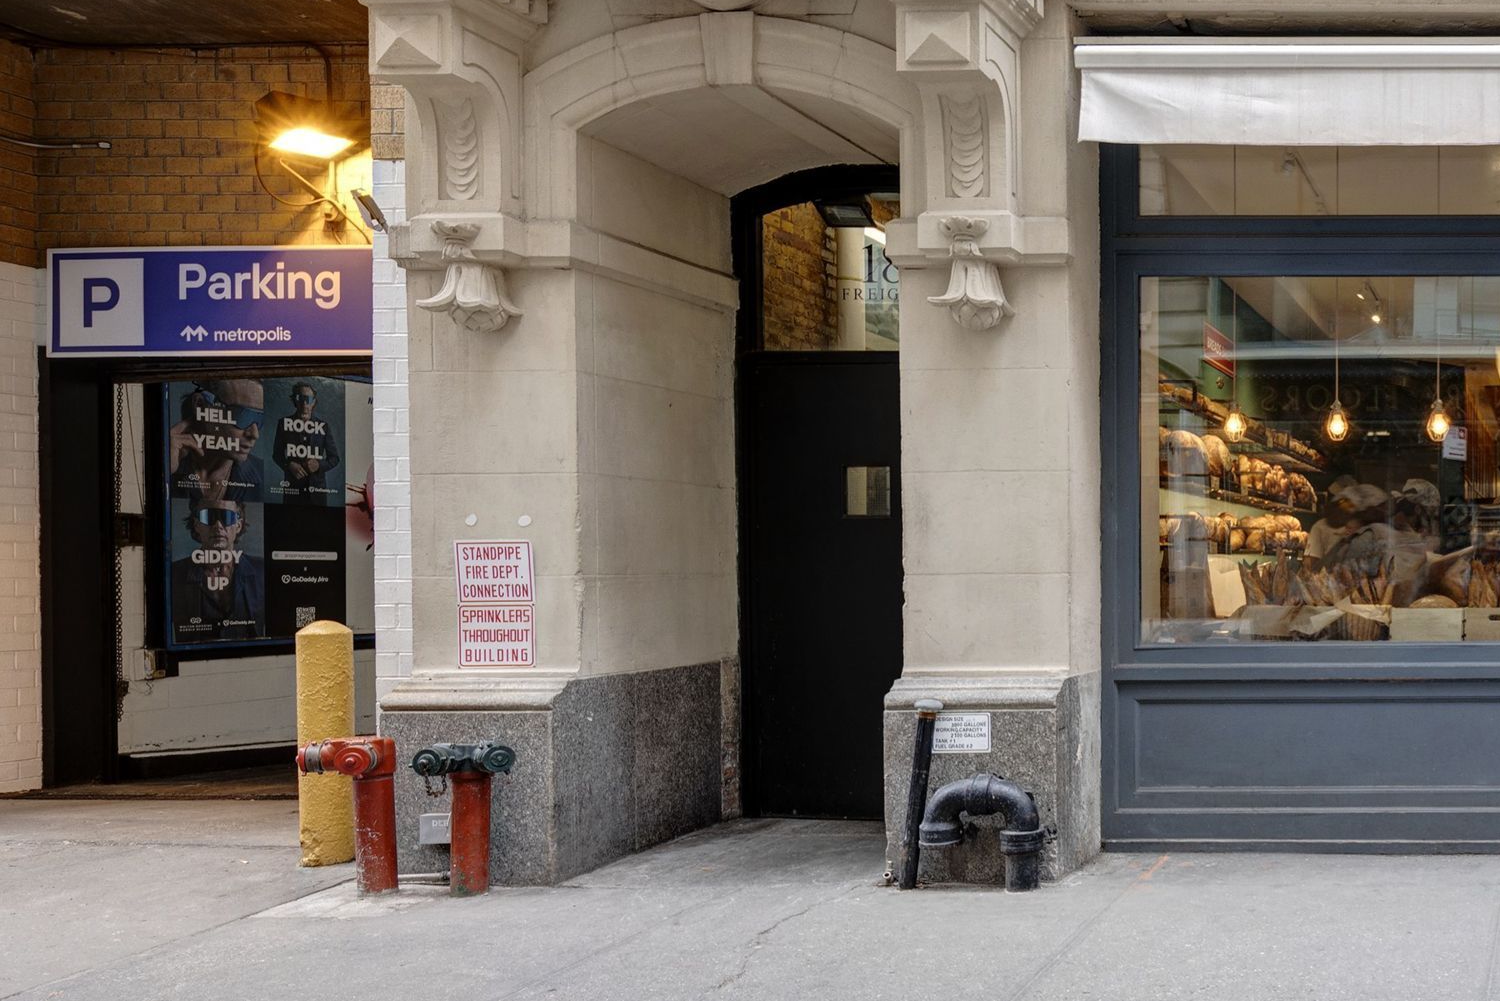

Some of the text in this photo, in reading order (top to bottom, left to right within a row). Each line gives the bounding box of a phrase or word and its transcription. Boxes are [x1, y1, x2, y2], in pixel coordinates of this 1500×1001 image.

[178, 262, 341, 310] Parking
[82, 277, 121, 328] P
[213, 325, 292, 345] metropolis
[196, 407, 237, 425] HELL
[283, 417, 326, 436] ROCK
[193, 433, 240, 452] YEAH
[287, 443, 324, 460] ROLL
[191, 549, 244, 564] GIDDY
[462, 546, 522, 560] STANDPIPE
[465, 565, 524, 579] FIRE DEPT.
[207, 576, 230, 591] UP
[463, 584, 529, 598] CONNECTION
[462, 609, 530, 623] SPRINKLERS
[462, 629, 531, 643] THROUGHOUT
[465, 648, 528, 662] BUILDING
